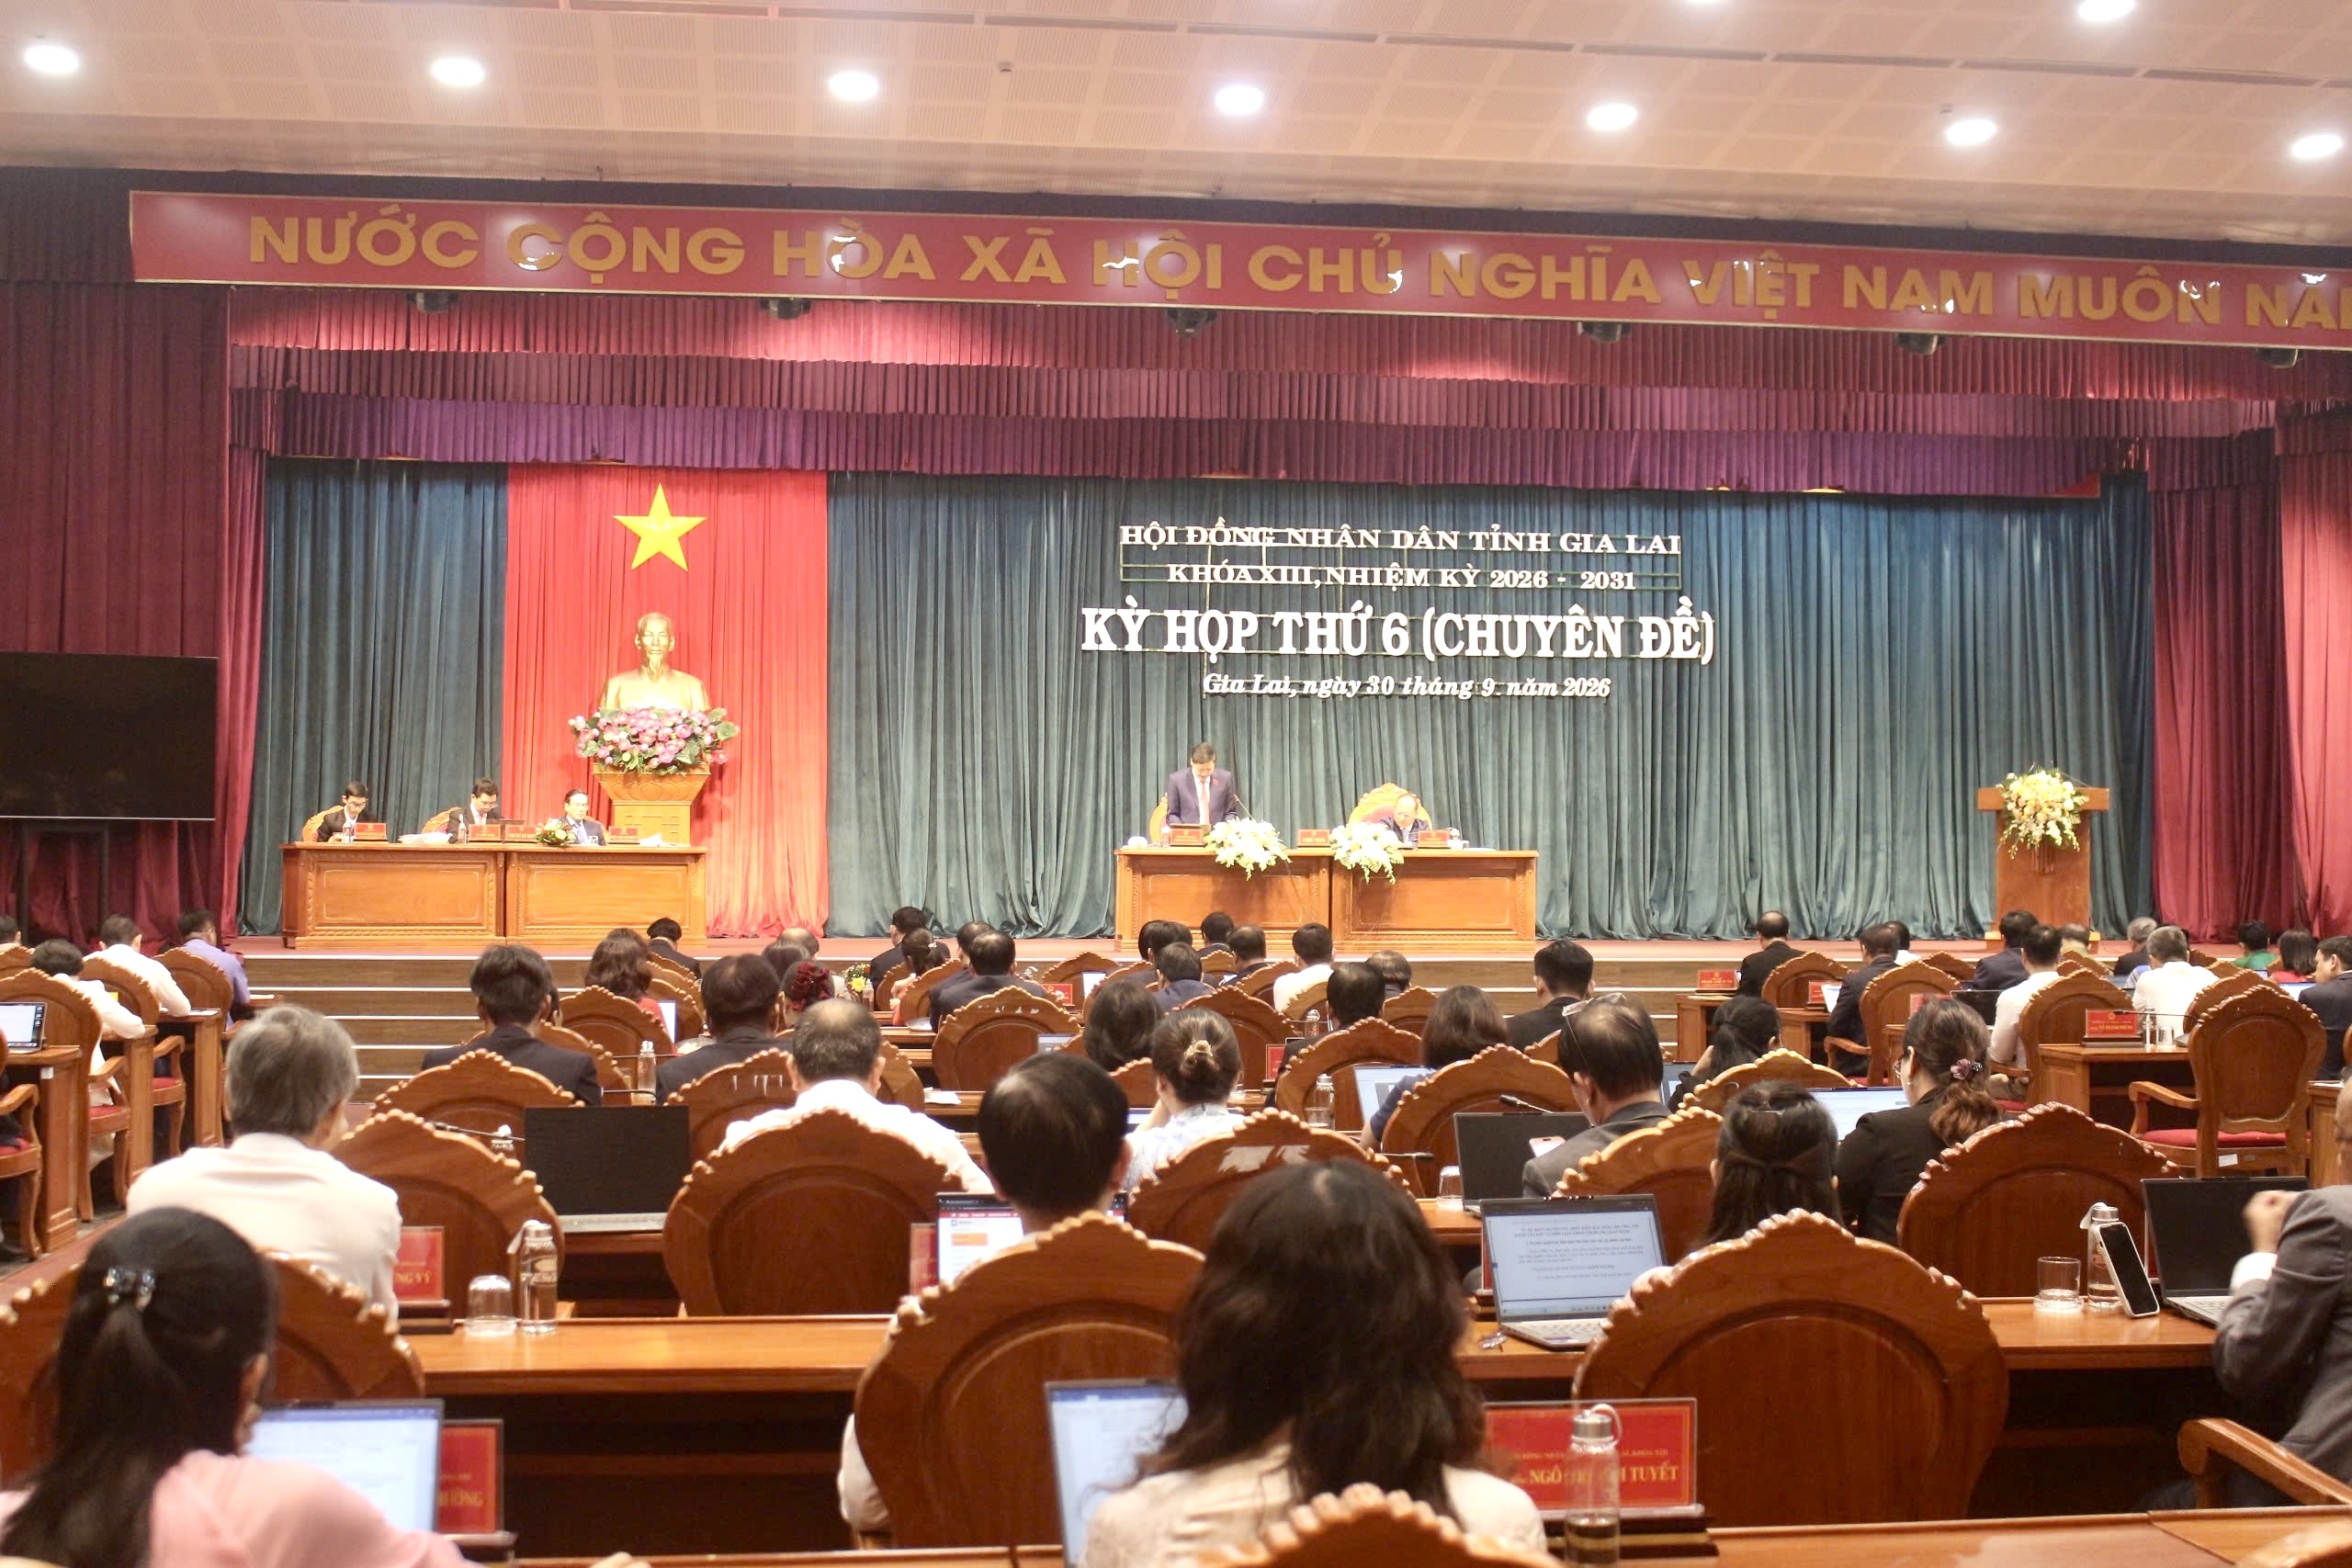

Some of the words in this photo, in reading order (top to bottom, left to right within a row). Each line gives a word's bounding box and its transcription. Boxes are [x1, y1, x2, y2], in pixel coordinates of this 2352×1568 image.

[249, 204, 478, 268] NƯỚC
[507, 211, 745, 284] CỘNG
[773, 218, 936, 280] HÒA
[961, 227, 1066, 284] XÃ
[1093, 229, 1221, 300] HỘI
[1248, 232, 1402, 294] CHỦ
[1430, 243, 1661, 304] NGHĨA
[1683, 249, 1819, 320] VIỆT
[1844, 265, 1994, 315] NAM
[2020, 266, 2220, 324] MUÔN
[1120, 521, 1178, 551] HỘI
[1185, 516, 1275, 547] ĐỒNG
[1287, 523, 1381, 549] NHÂN
[1391, 525, 1460, 550] DÂN
[1469, 524, 1551, 552] TỈNH
[1559, 533, 1617, 554] GIA
[1625, 535, 1681, 555] LAI
[1167, 558, 1255, 583] KHÓA
[1325, 562, 1430, 592] NHIỆM
[1439, 563, 1481, 588] KỲ
[1490, 570, 1548, 589] 2026
[1580, 570, 1636, 590] 2031
[1081, 595, 1150, 651] KỲ
[1164, 610, 1259, 663] HỌP
[1272, 600, 1374, 656] THỨ
[1382, 612, 1410, 656] 6
[1423, 604, 1624, 661] (CHUYÊN
[1639, 596, 1714, 665] ĐỀ)
[1203, 673, 1246, 694] Gia
[1253, 674, 1297, 698] Lai,
[1303, 678, 1362, 698] ngày
[1366, 676, 1397, 696] 30
[1402, 676, 1473, 700] tháng
[1506, 678, 1558, 697] năm
[1563, 677, 1611, 698] 2026
[1530, 1464, 1562, 1484] NGÔ
[1631, 1460, 1679, 1483] TUYẾT
